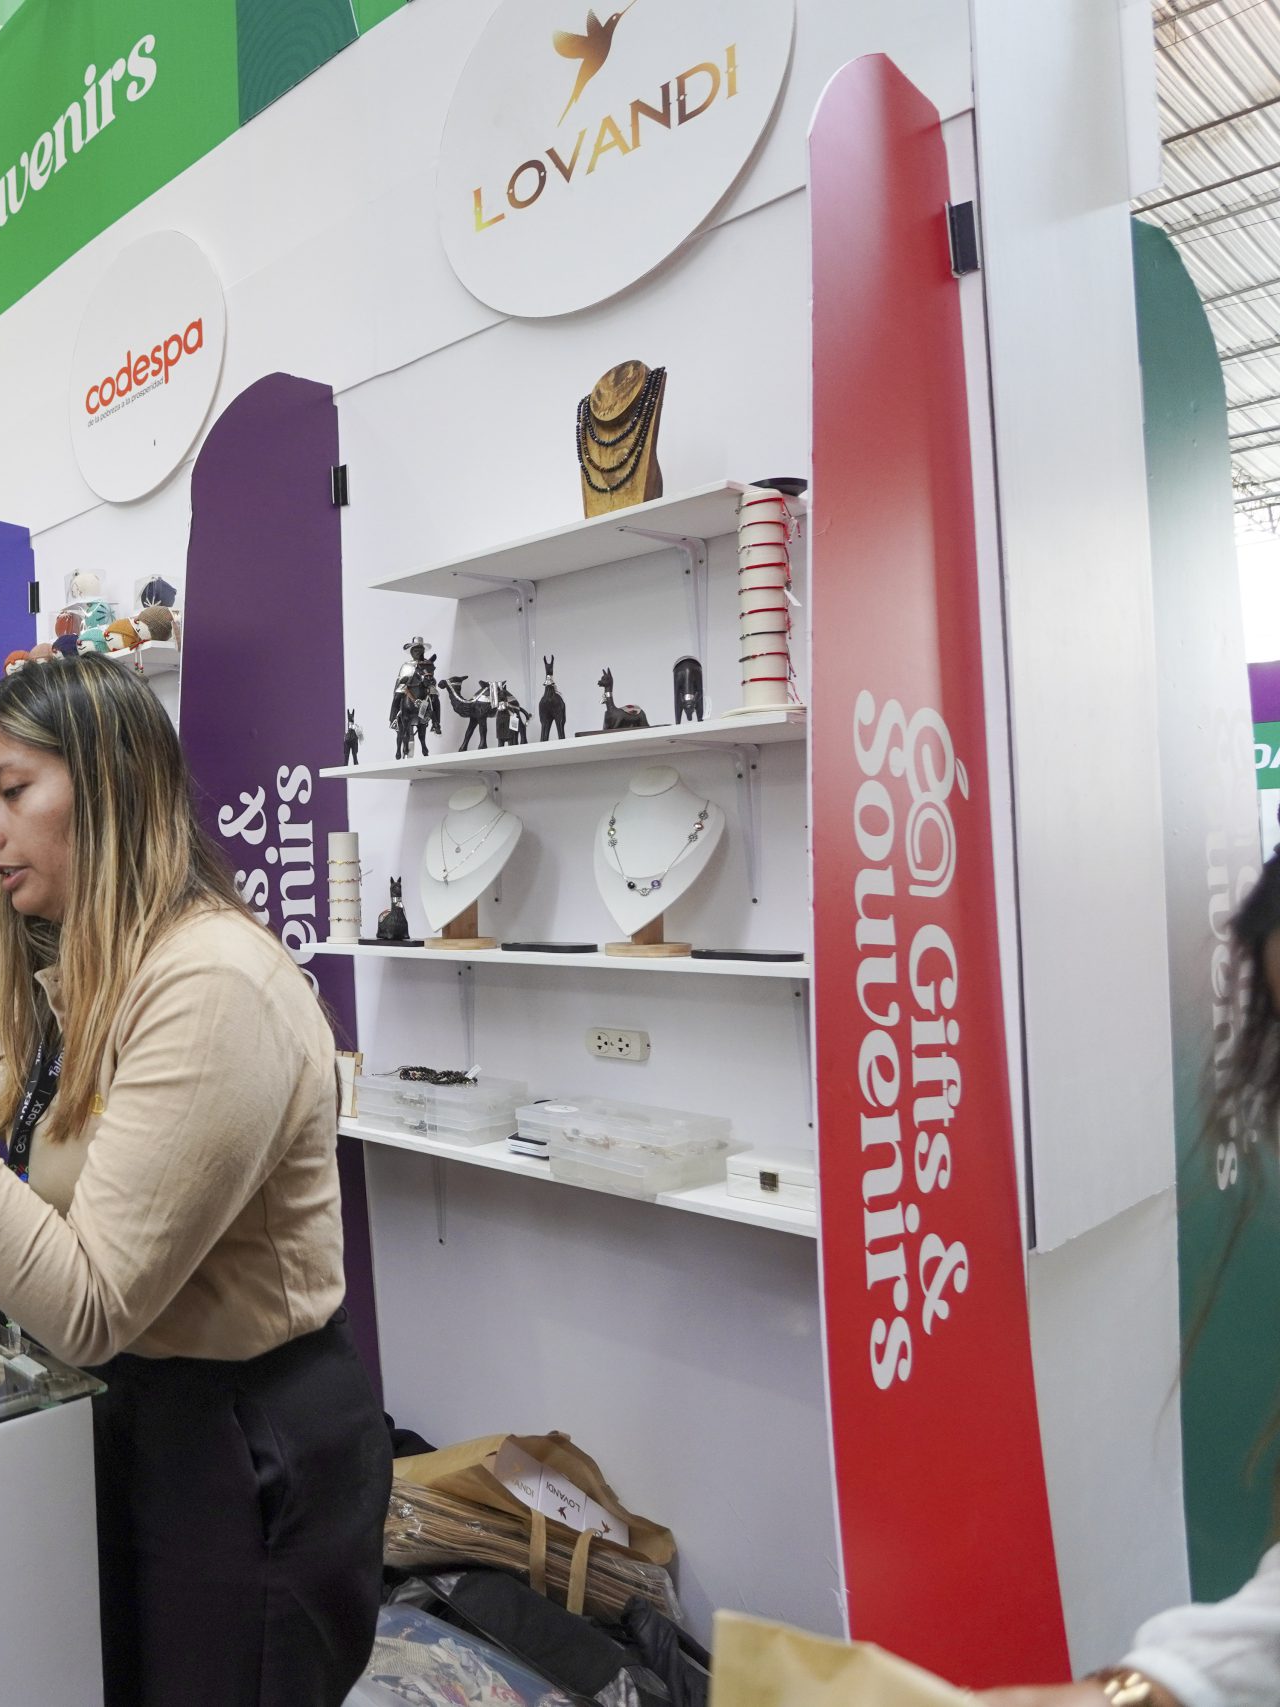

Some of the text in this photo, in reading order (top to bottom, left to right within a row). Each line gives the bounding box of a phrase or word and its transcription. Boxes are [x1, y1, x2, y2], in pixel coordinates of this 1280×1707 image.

[473, 43, 738, 233] LOVANDI
[85, 317, 203, 415] codespa
[218, 786, 267, 845] &
[853, 690, 919, 1390] Souvenirs
[909, 924, 961, 1193] Gifts
[25, 1100, 45, 1126] ADEX
[919, 1233, 969, 1335] &
[545, 1481, 581, 1512] LOVANDI
